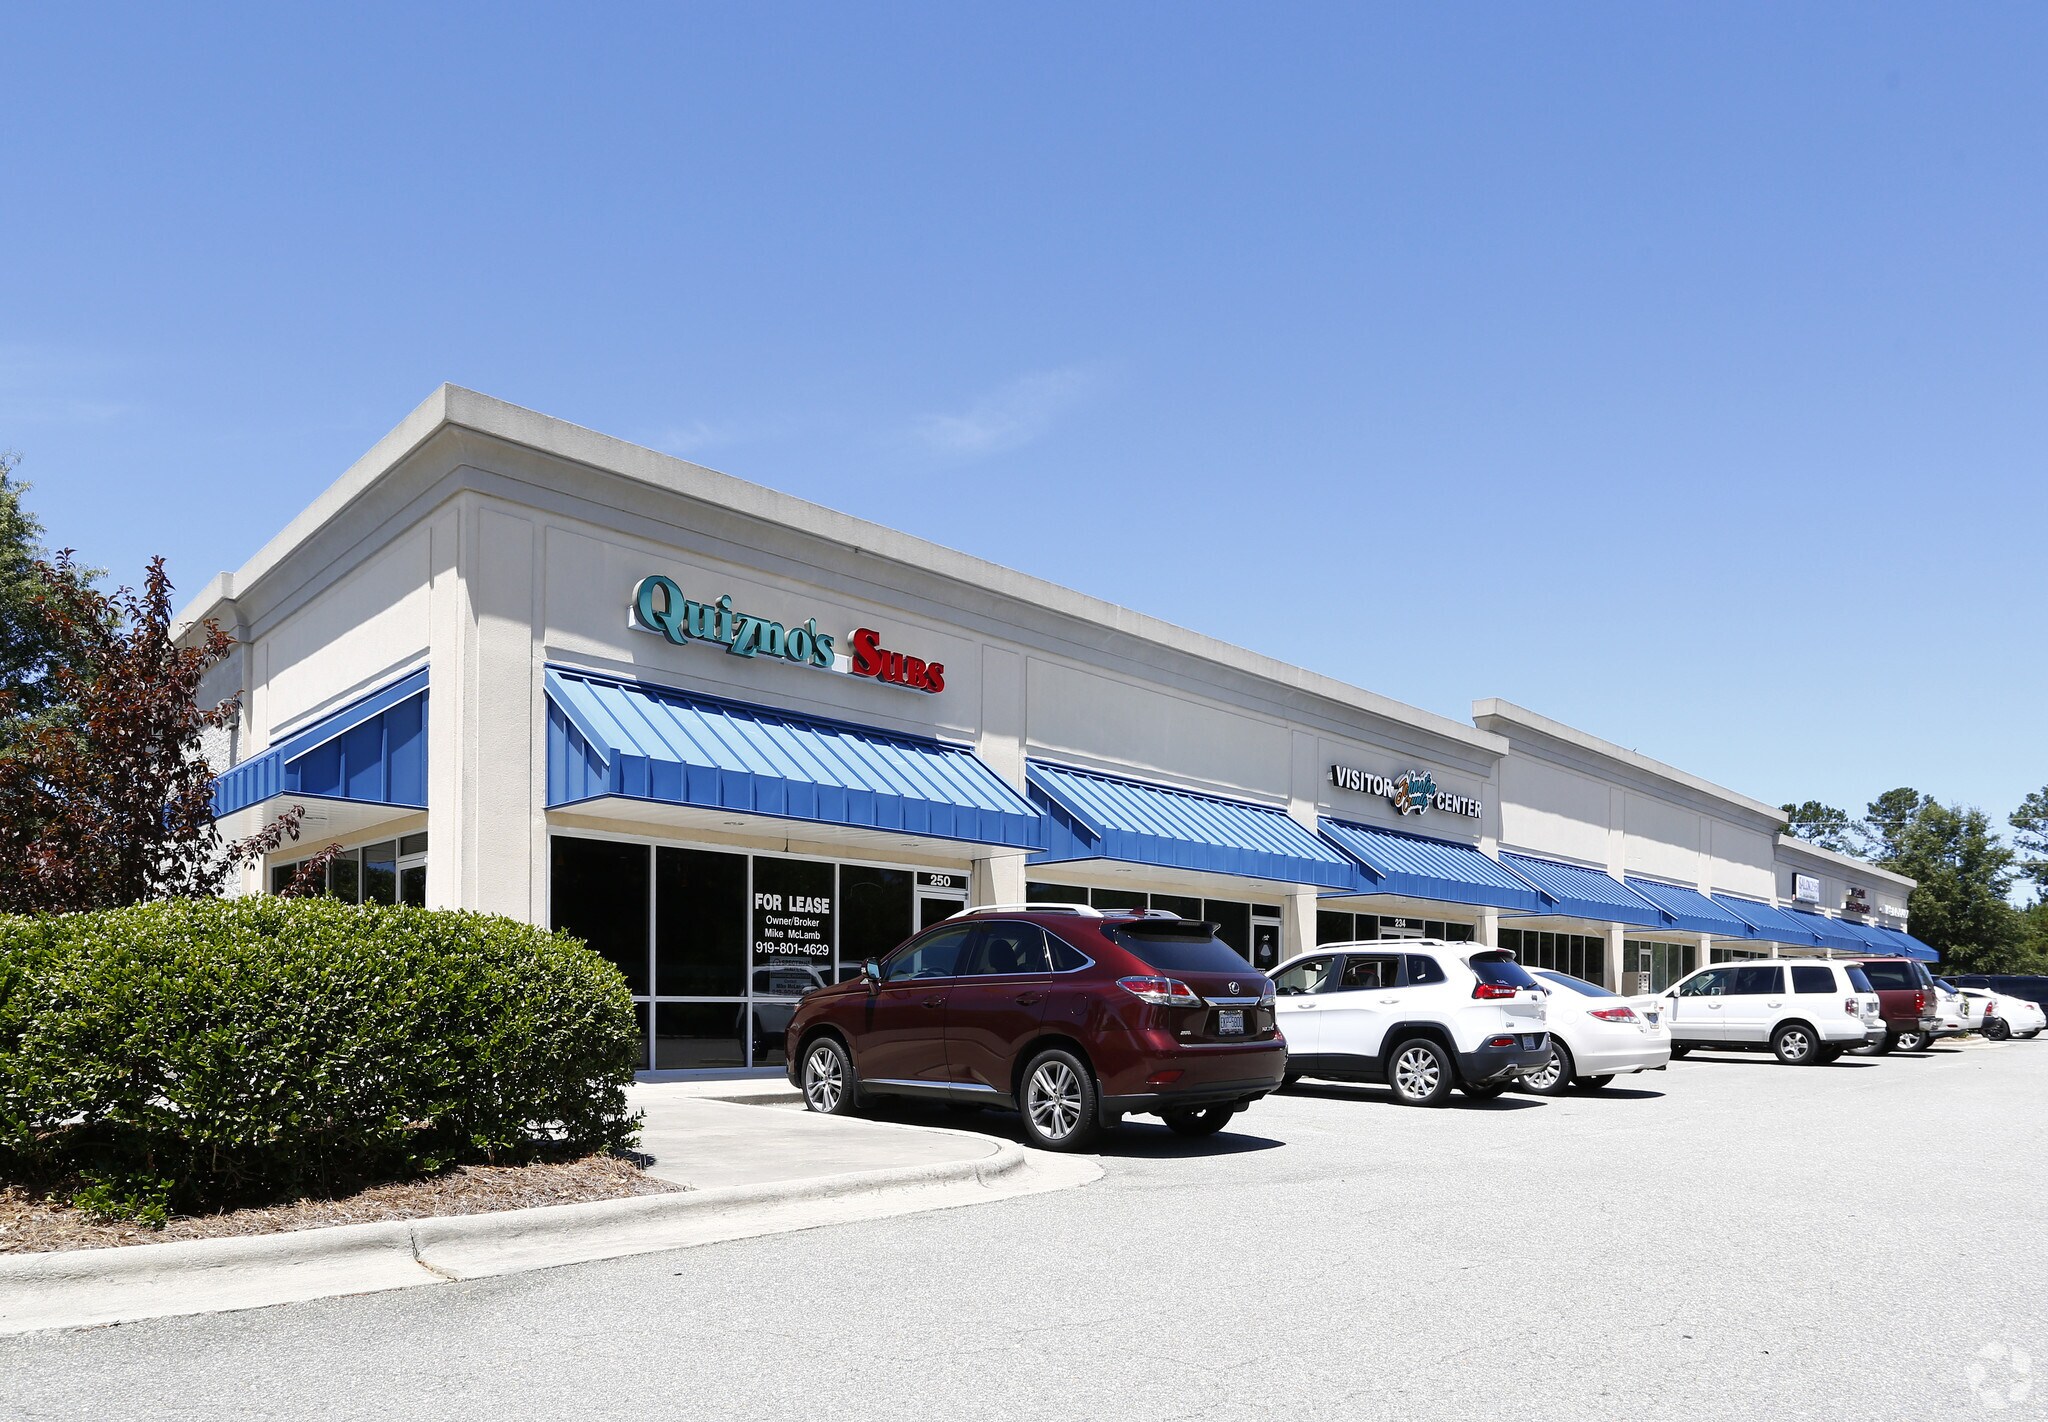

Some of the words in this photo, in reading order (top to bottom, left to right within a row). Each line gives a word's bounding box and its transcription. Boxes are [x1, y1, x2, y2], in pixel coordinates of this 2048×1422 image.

[632, 575, 835, 667] Quizno's
[1334, 765, 1393, 798] VISITOR
[1437, 792, 1482, 818] CENTER
[930, 874, 951, 887] 250
[755, 893, 782, 911] FOR
[789, 895, 830, 914] LEASE
[765, 915, 820, 927] Owner/Broker
[1395, 918, 1406, 927] 234
[764, 928, 784, 938] Mike
[788, 930, 821, 940] McLamb
[755, 941, 829, 956] 919-801-4629
